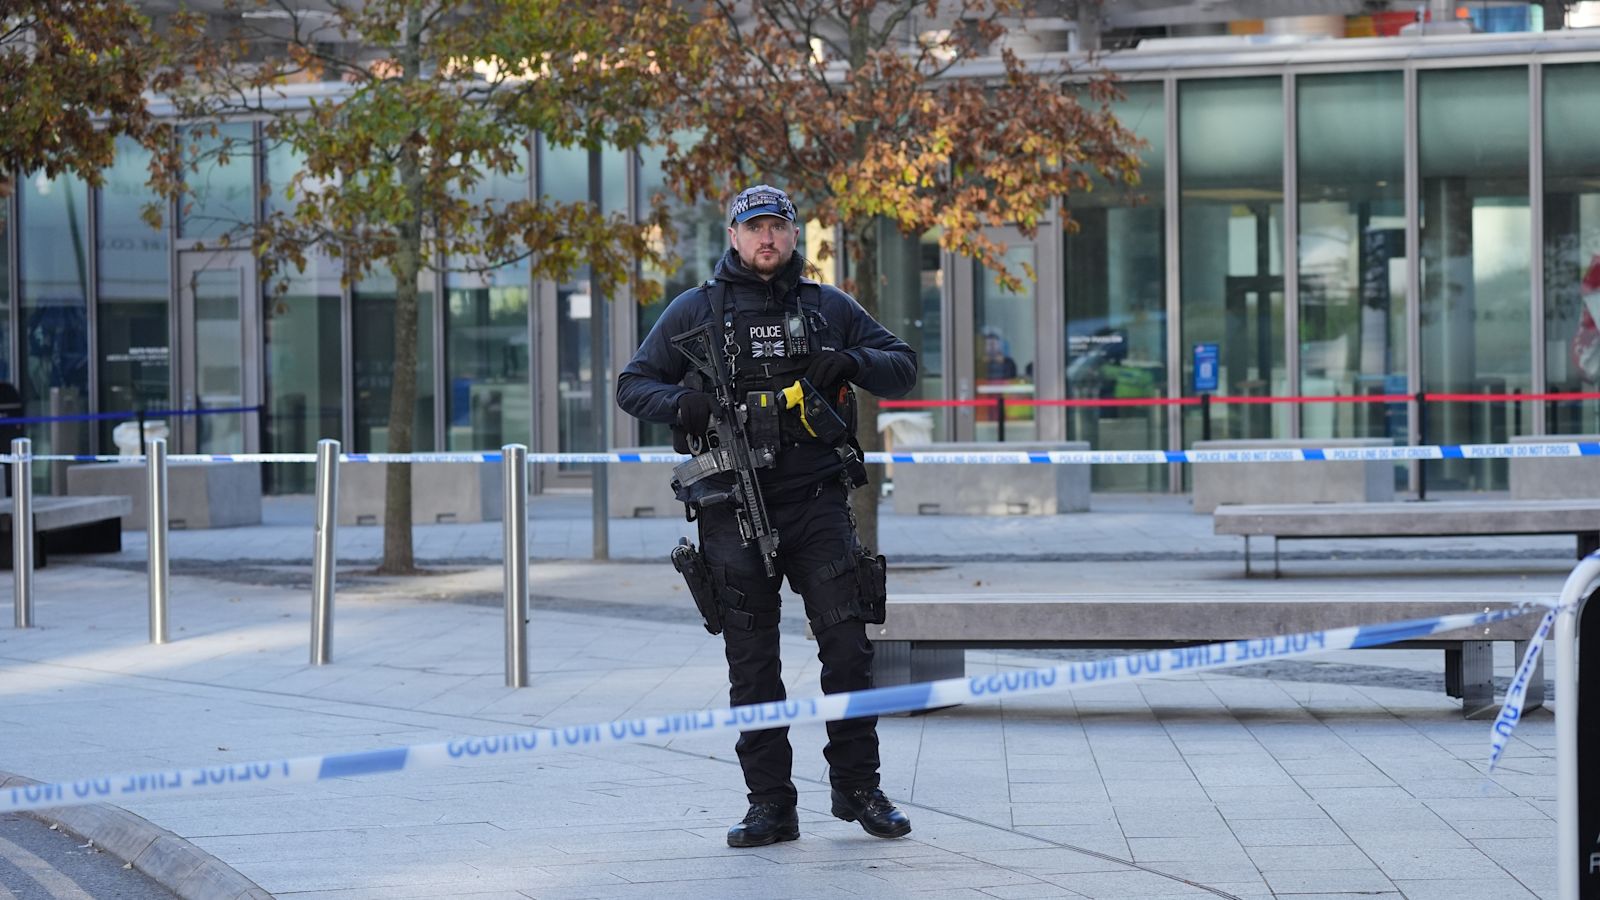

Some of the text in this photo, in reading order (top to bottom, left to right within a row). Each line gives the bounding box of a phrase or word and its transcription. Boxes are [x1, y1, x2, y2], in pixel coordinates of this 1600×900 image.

[750, 325, 782, 339] POLICE
[1334, 449, 1432, 459] POLICE LINE DO NOT CROSS
[1472, 446, 1570, 456] POLICE LINE DO NOT CROSS
[922, 455, 1020, 463] POLICE LINE DO NOT CROSS
[1060, 454, 1156, 462] POLICE LINE DO NOT CROSS
[1196, 452, 1294, 461] POLICE LINE DO NOT CROSS
